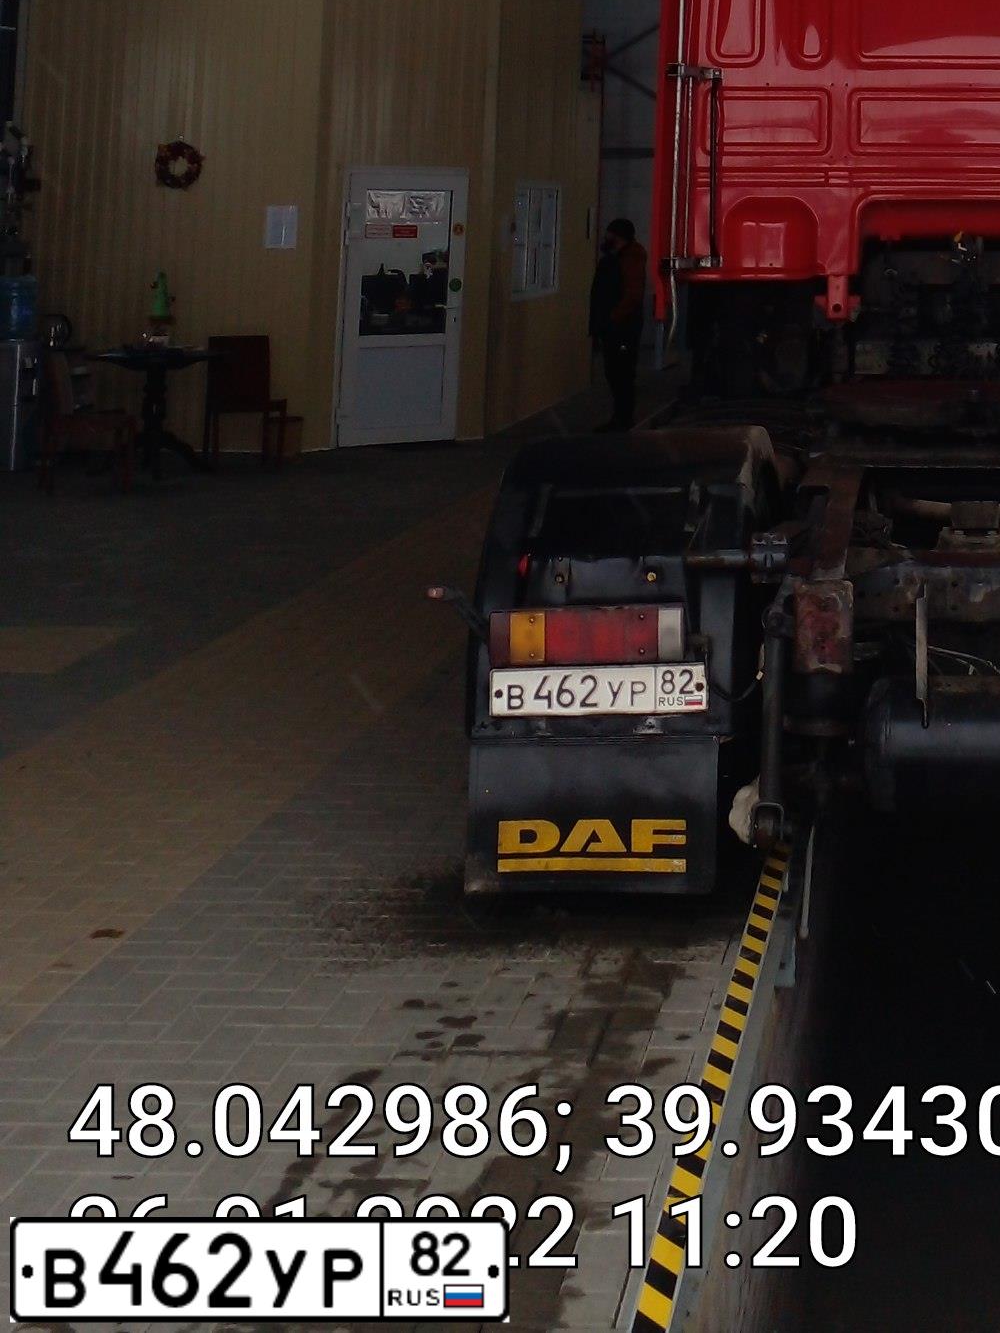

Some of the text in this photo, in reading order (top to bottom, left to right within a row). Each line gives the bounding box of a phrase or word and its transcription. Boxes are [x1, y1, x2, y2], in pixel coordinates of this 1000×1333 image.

[661, 669, 694, 695] 82
[658, 696, 684, 707] RUS
[497, 819, 688, 855] DAF
